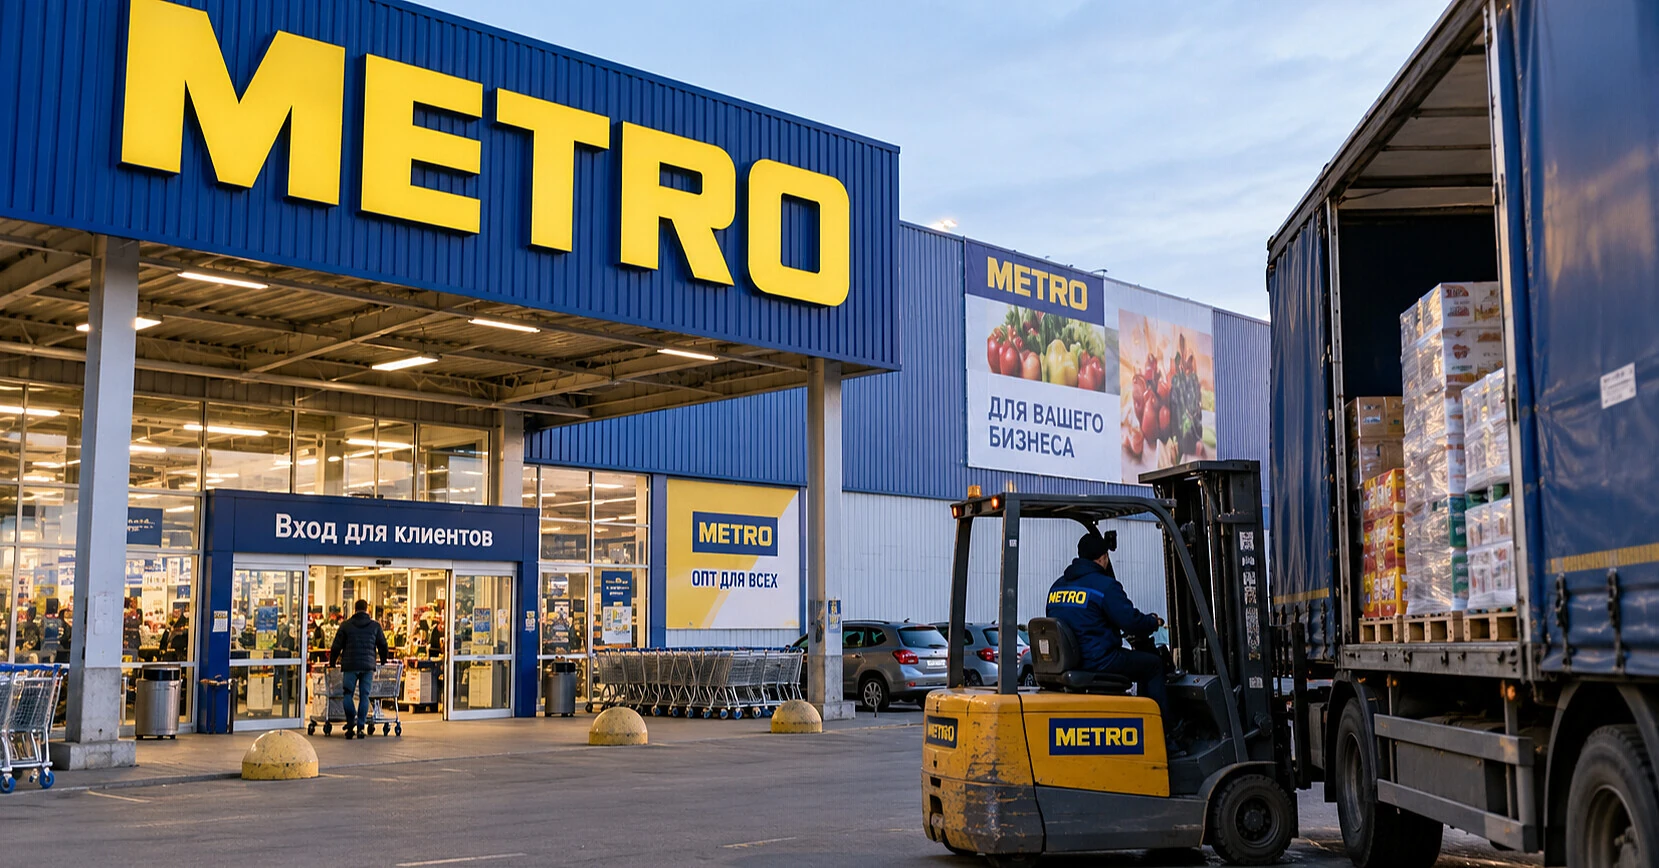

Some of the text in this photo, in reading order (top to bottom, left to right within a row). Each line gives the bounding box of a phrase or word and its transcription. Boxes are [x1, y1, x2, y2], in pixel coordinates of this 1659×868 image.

[121, 0, 850, 307] METRO
[987, 256, 1088, 312] METRO
[988, 396, 1104, 434] ДЛЯ ВАШЕГО
[988, 425, 1075, 458] БИЗНЕСА
[275, 513, 494, 547] Вход для клиентов
[698, 521, 773, 547] METRO
[692, 570, 778, 589] ОПТ ДЛЯ ВСЕХ
[1048, 590, 1087, 605] METRO
[1055, 727, 1138, 747] METRO
